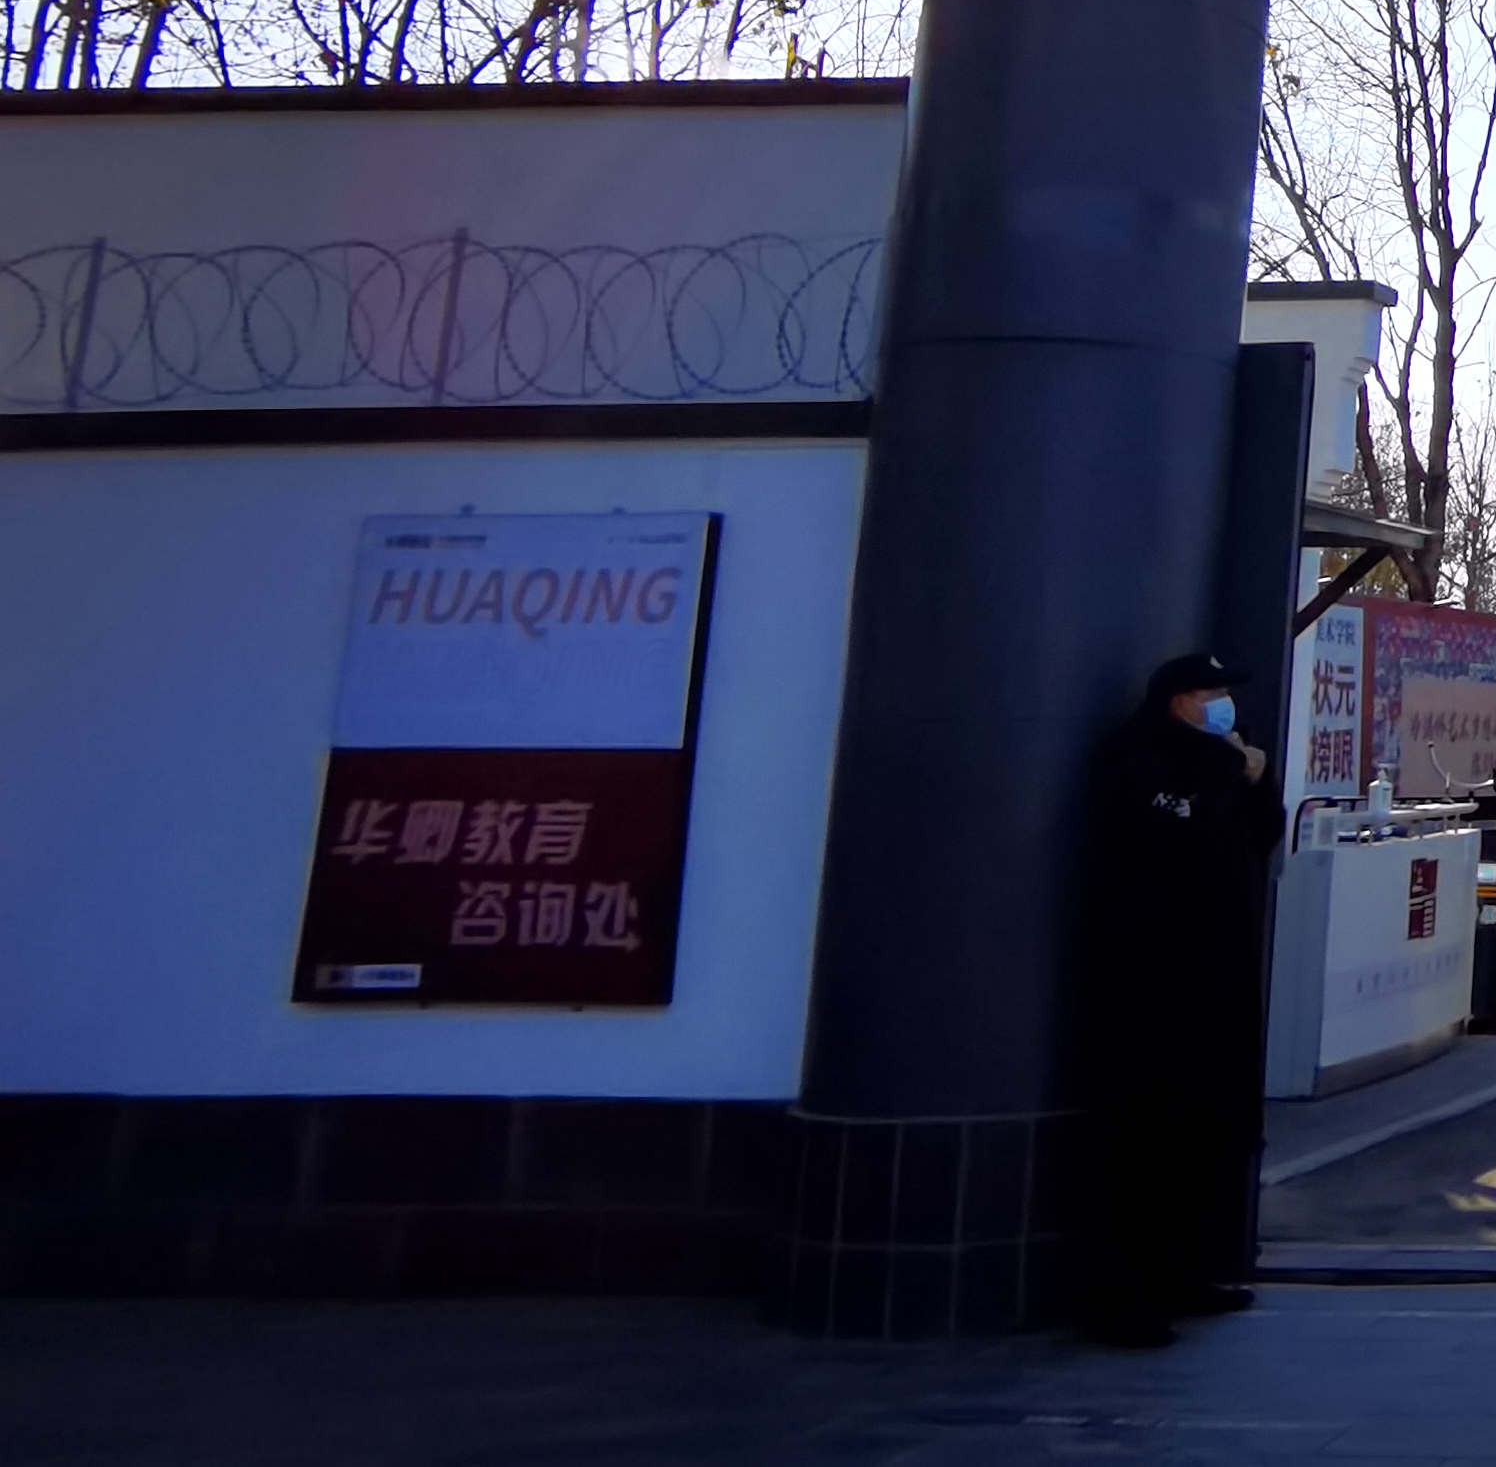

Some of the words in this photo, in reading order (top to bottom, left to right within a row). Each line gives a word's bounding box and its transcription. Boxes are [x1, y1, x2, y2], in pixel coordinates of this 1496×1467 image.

[369, 566, 683, 638] HUAQING
[1311, 658, 1357, 717] 状元
[1306, 726, 1355, 783] 榜眼
[333, 799, 594, 866] 华卿教育
[449, 879, 642, 953] 咨询处
